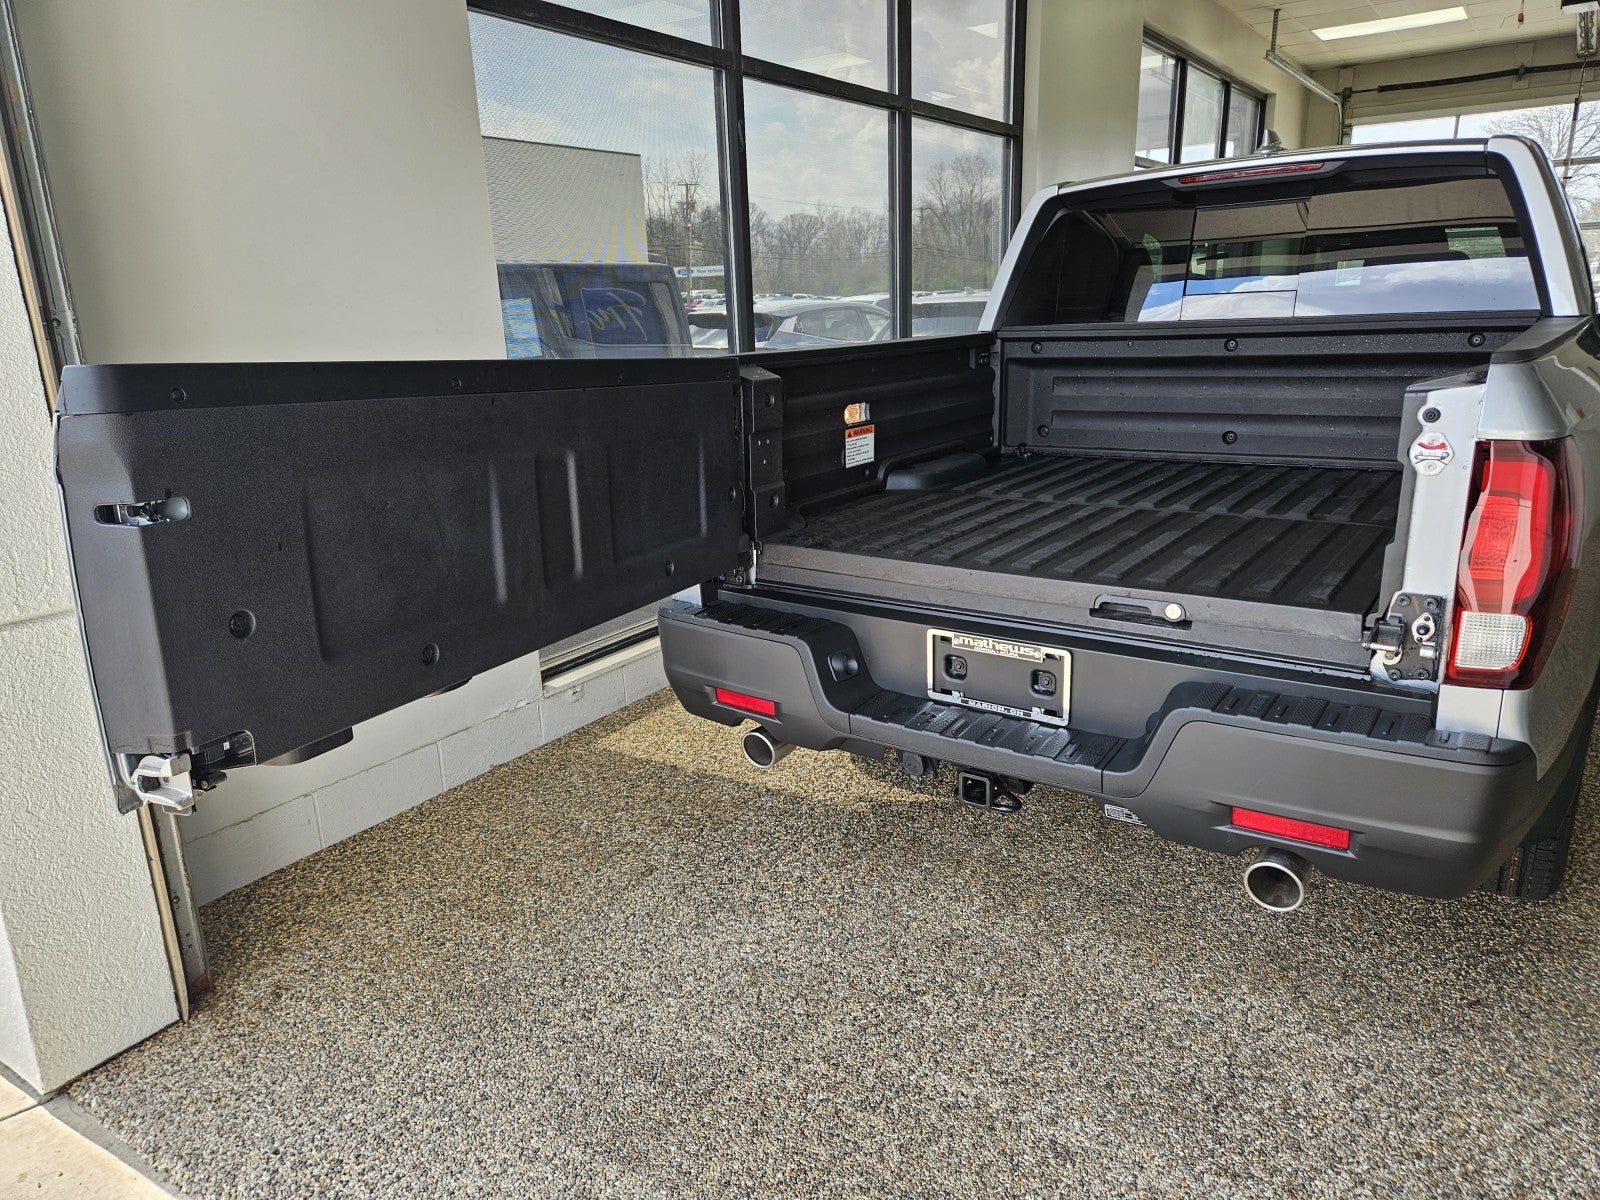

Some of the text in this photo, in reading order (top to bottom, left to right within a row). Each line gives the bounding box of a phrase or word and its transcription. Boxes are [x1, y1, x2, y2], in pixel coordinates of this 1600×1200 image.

[853, 426, 873, 437] WARNING
[959, 636, 1035, 656] mathews
[968, 700, 1024, 717] MARION, OH
